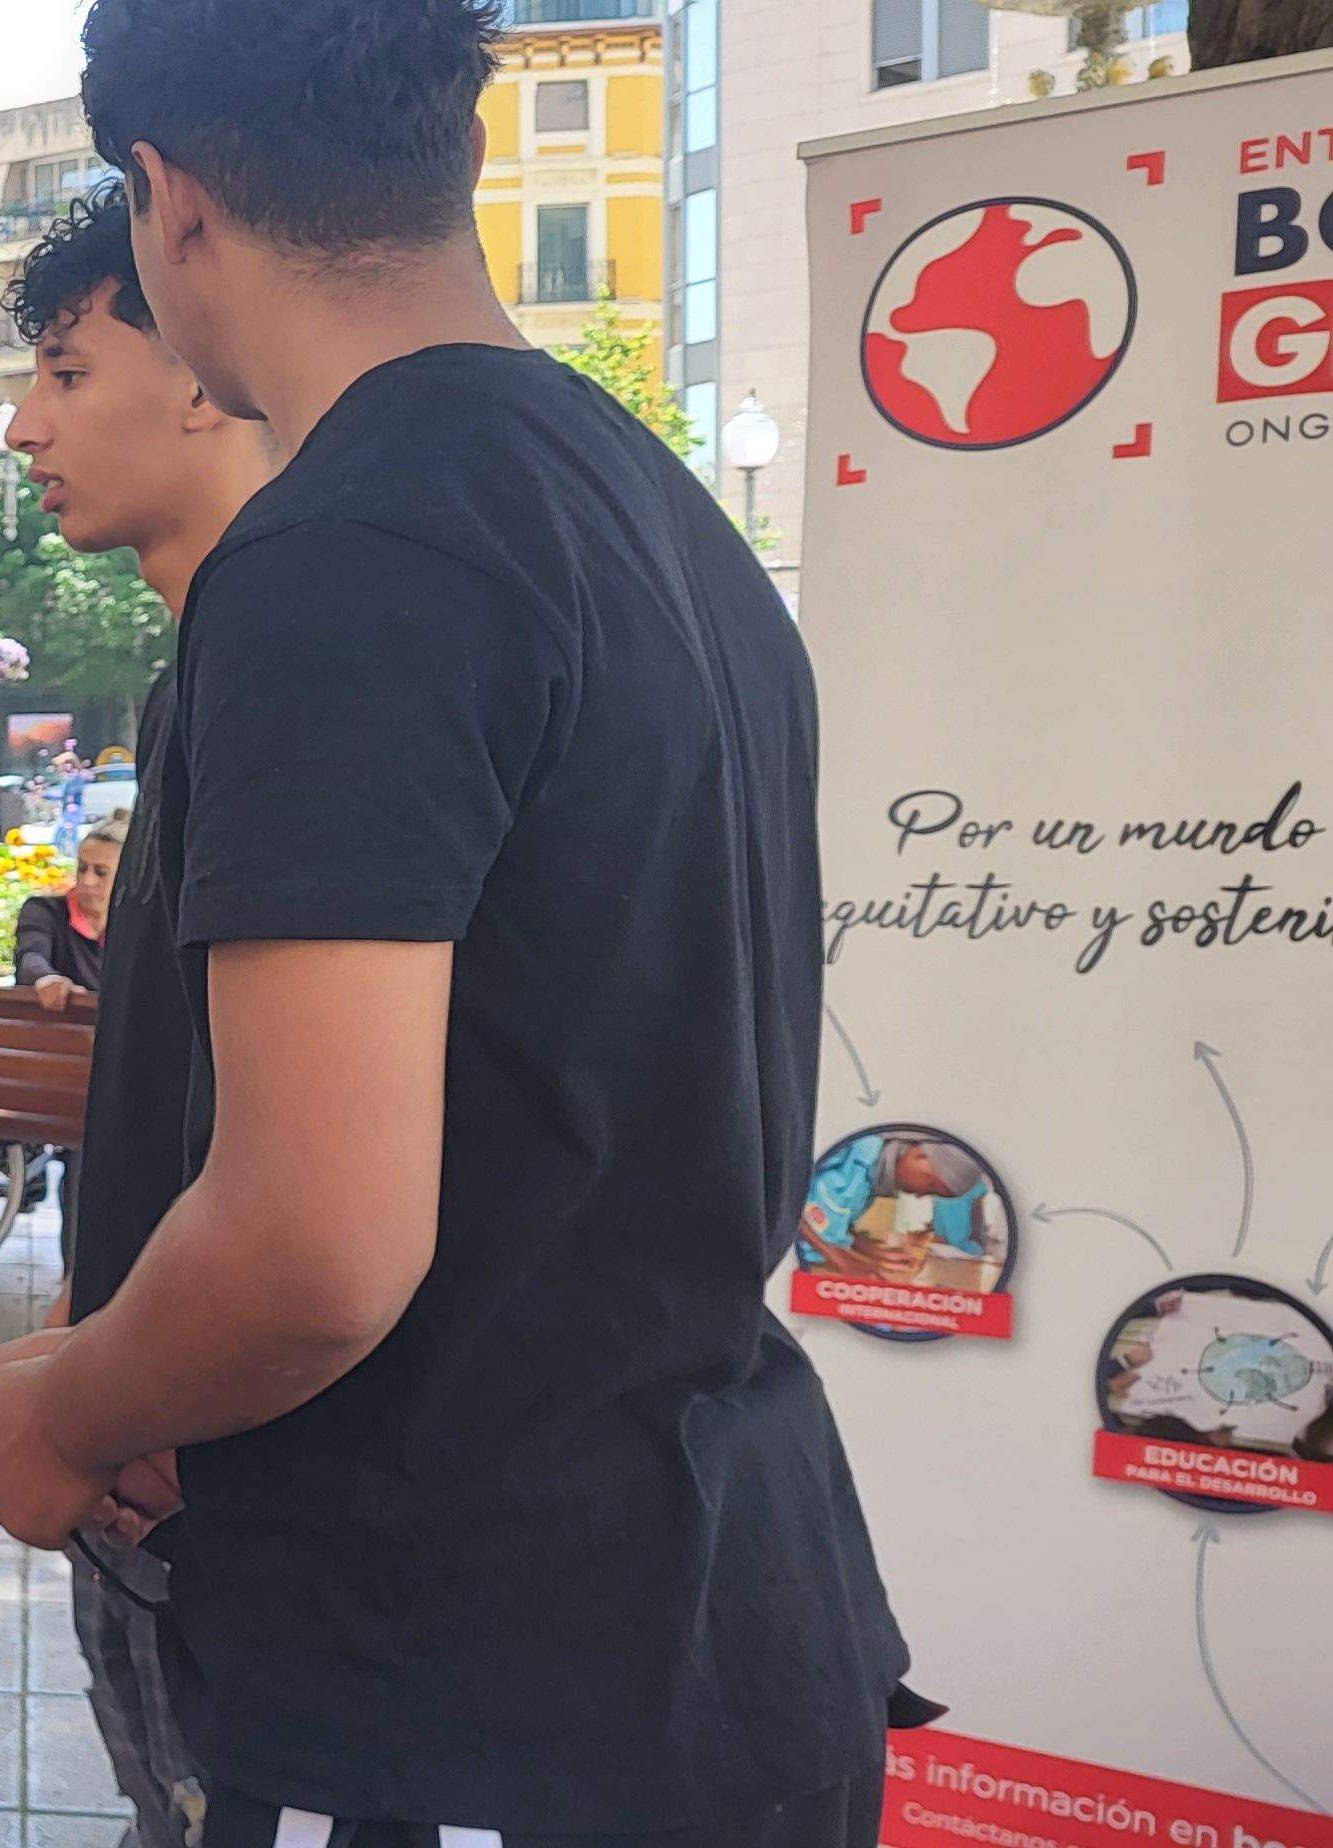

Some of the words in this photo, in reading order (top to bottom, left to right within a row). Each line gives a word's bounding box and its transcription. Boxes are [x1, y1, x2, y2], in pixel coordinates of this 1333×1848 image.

[1234, 186, 1333, 276] B
[1225, 412, 1330, 447] ONG
[889, 790, 1014, 854] Por
[1032, 817, 1106, 854] un
[1119, 781, 1326, 854] mundo
[820, 872, 1077, 965] quitativo
[1075, 901, 1134, 974] y
[815, 1279, 983, 1317] COOPERACIÓN
[839, 1303, 960, 1330] INTERNACIONAL
[1125, 1464, 1171, 1482] PARA
[1175, 1472, 1196, 1488] EL
[1199, 1475, 1317, 1506] DESARROLLO
[1144, 1444, 1299, 1486] EDUCACIÓN
[926, 1754, 1156, 1838] información
[1169, 1819, 1219, 1848] en
